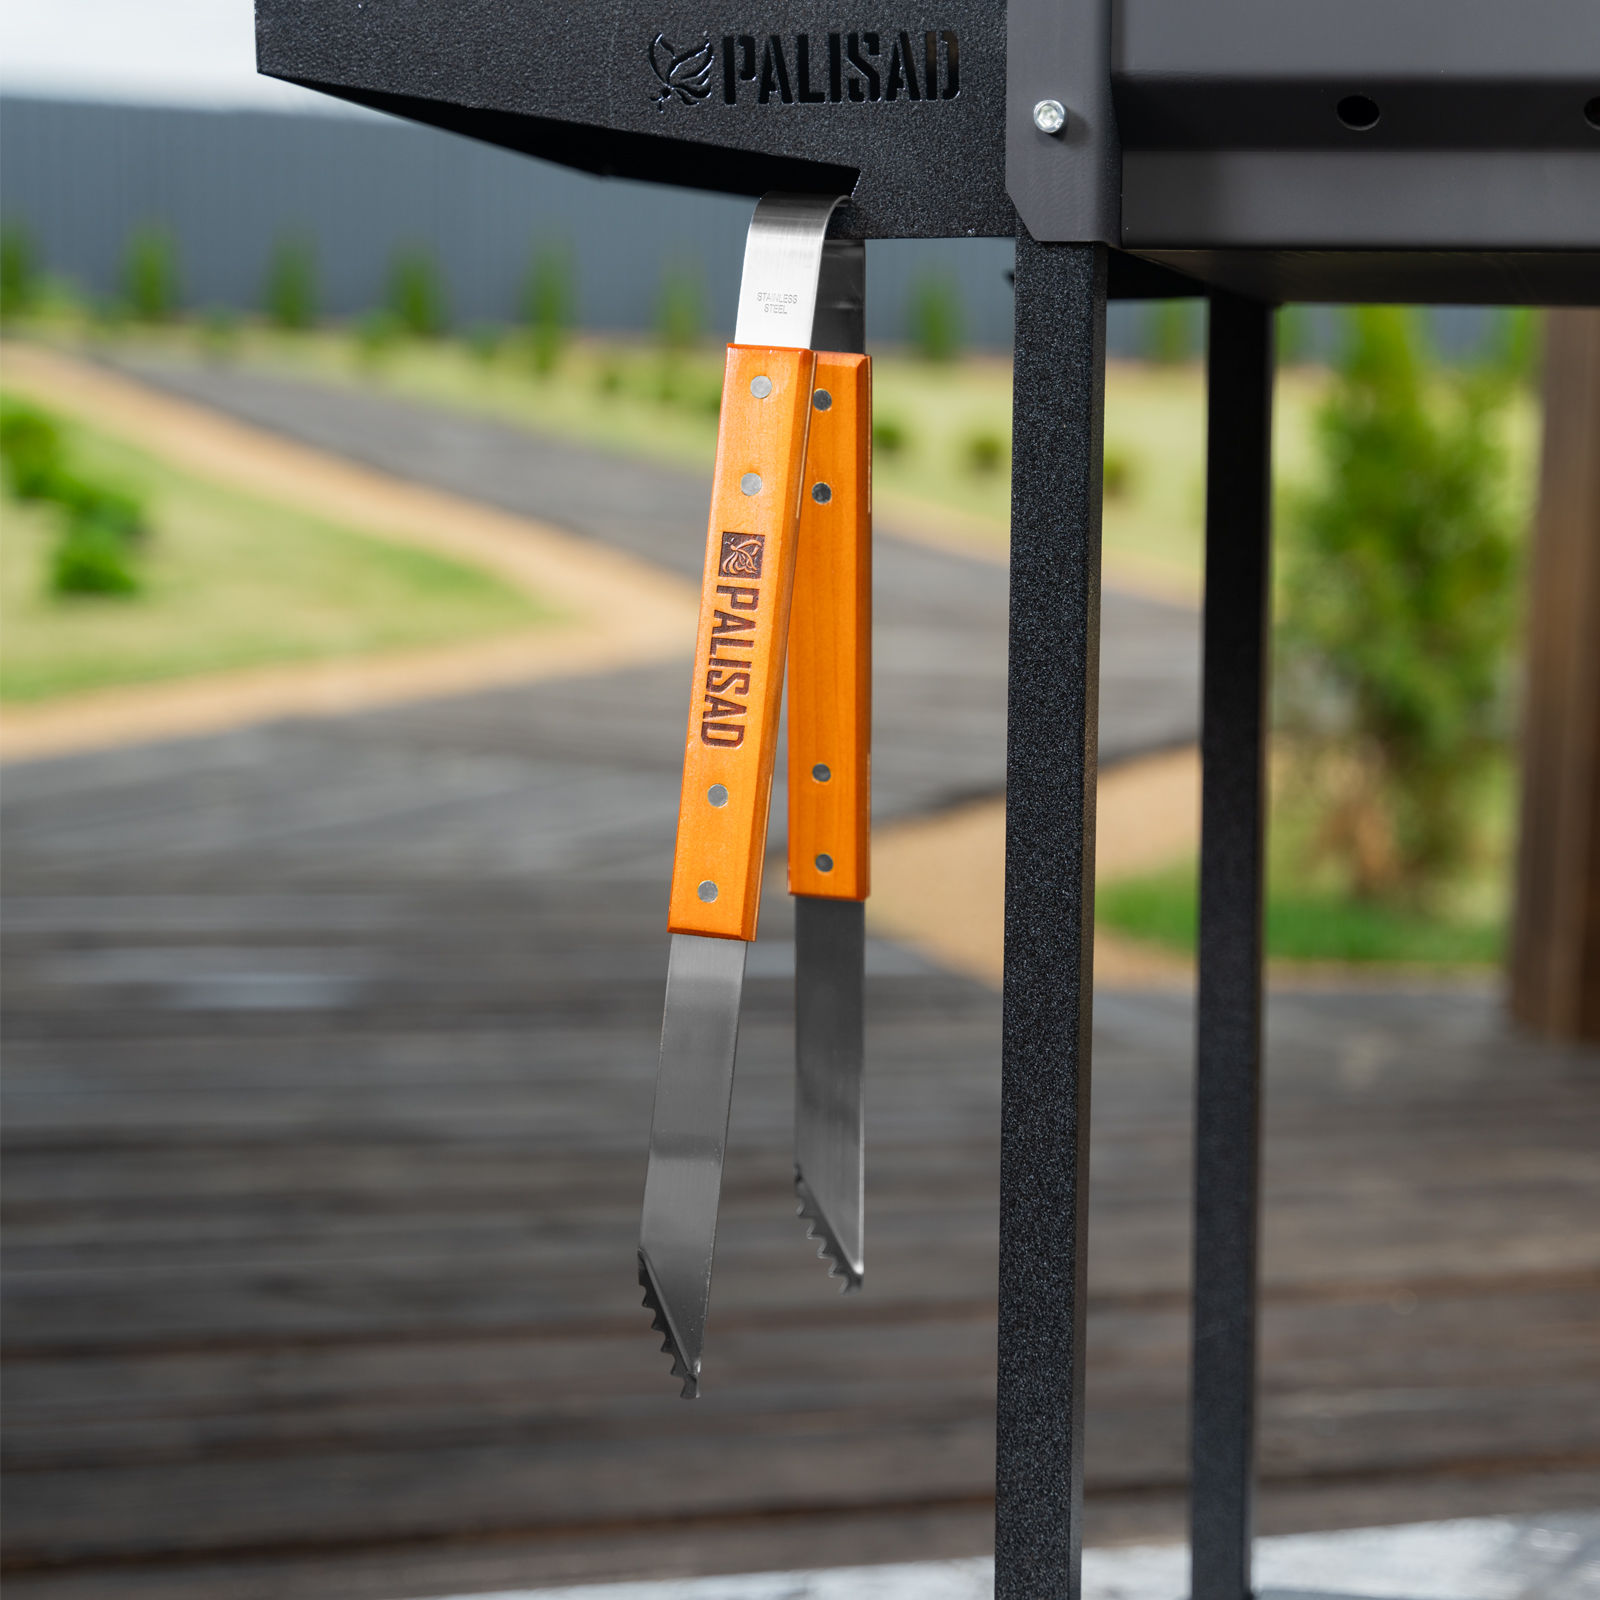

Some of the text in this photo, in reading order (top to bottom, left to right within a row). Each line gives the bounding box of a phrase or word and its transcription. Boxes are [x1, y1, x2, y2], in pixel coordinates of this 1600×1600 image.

[722, 31, 960, 106] PALISAD
[757, 292, 798, 304] STAINLESS
[764, 303, 788, 314] STEEL
[701, 585, 760, 749] PALISAD
